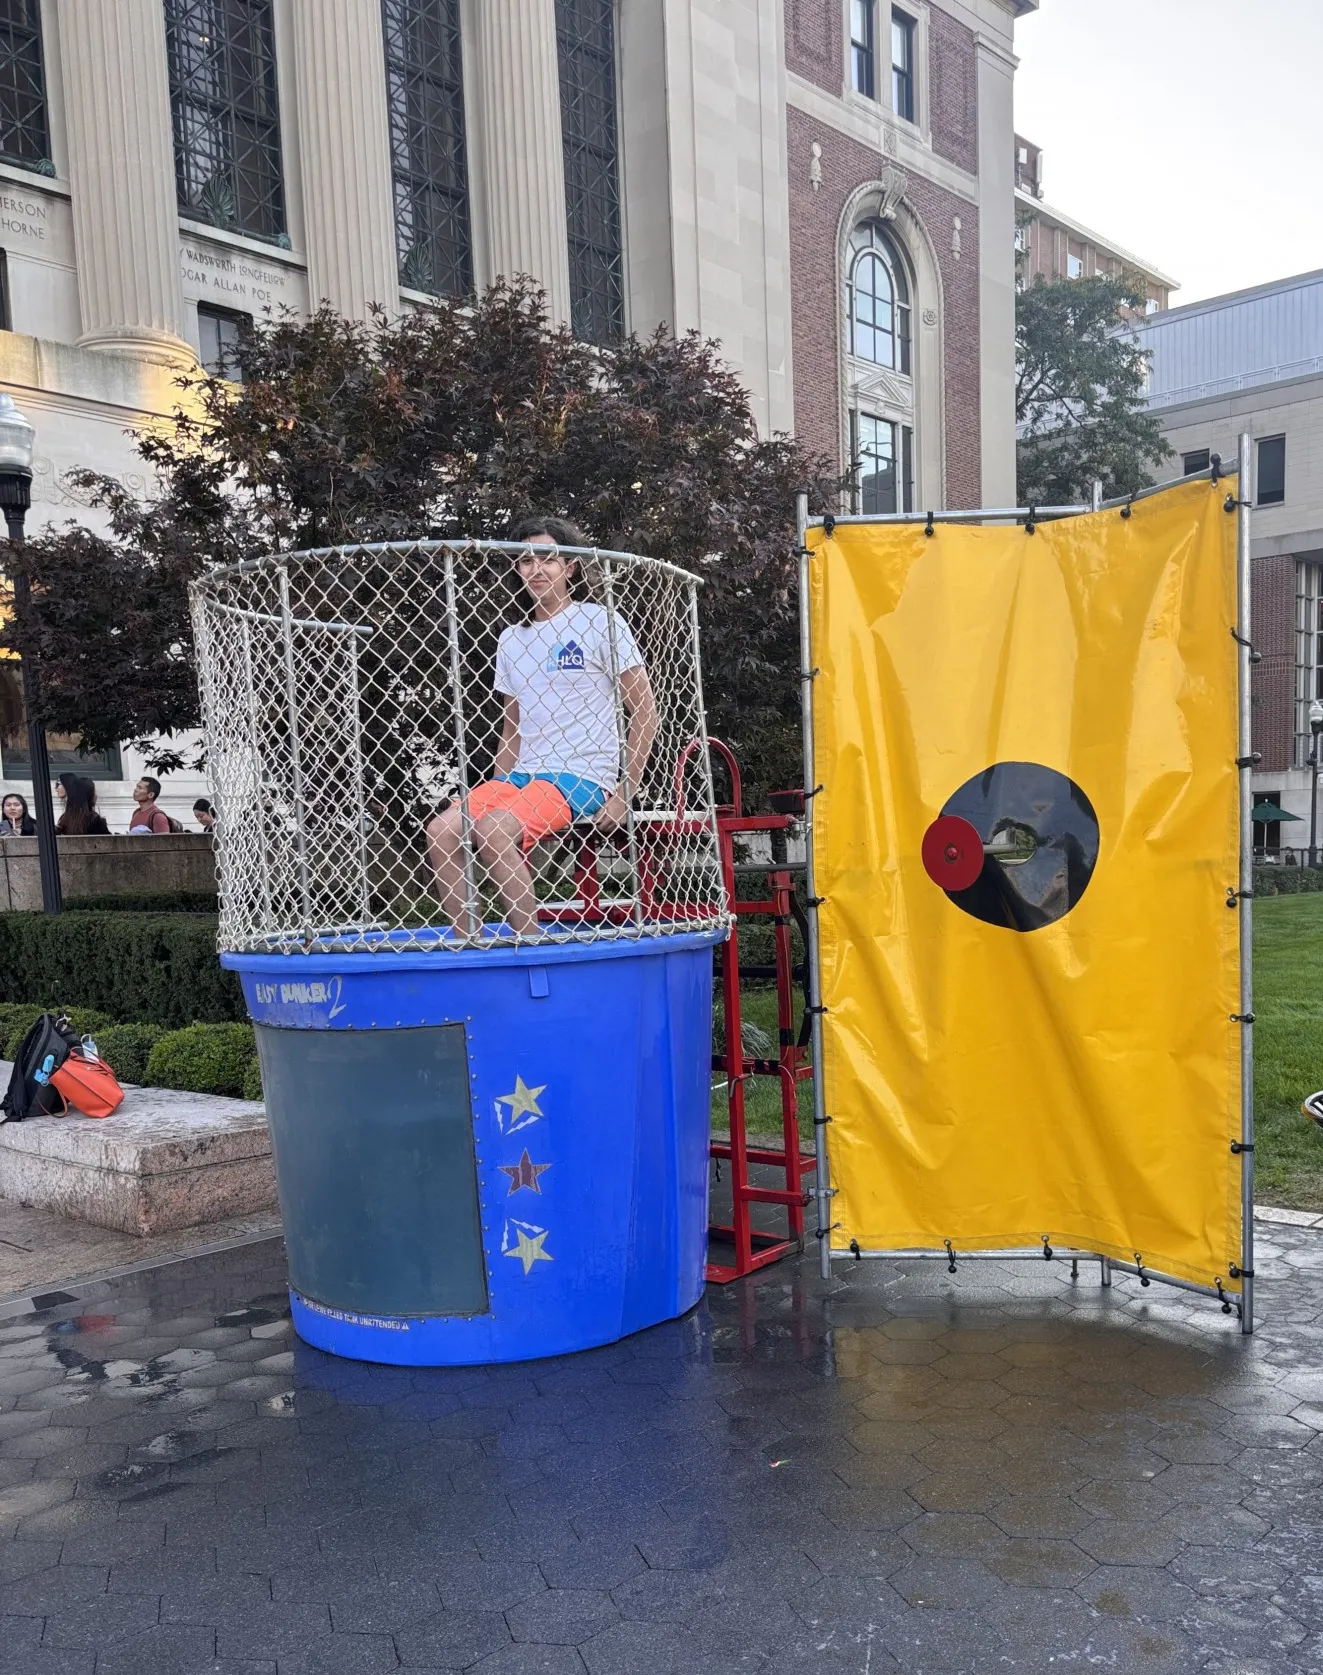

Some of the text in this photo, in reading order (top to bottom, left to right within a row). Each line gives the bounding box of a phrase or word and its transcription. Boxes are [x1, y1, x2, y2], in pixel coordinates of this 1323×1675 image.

[0, 196, 46, 218] ERSON
[186, 248, 236, 273] WADSWORTH
[239, 264, 286, 287] LONGFELLOW
[213, 277, 246, 295] ALLAN
[252, 287, 272, 302] POE
[255, 983, 278, 1004] EASY
[280, 982, 328, 1004] DUNKER
